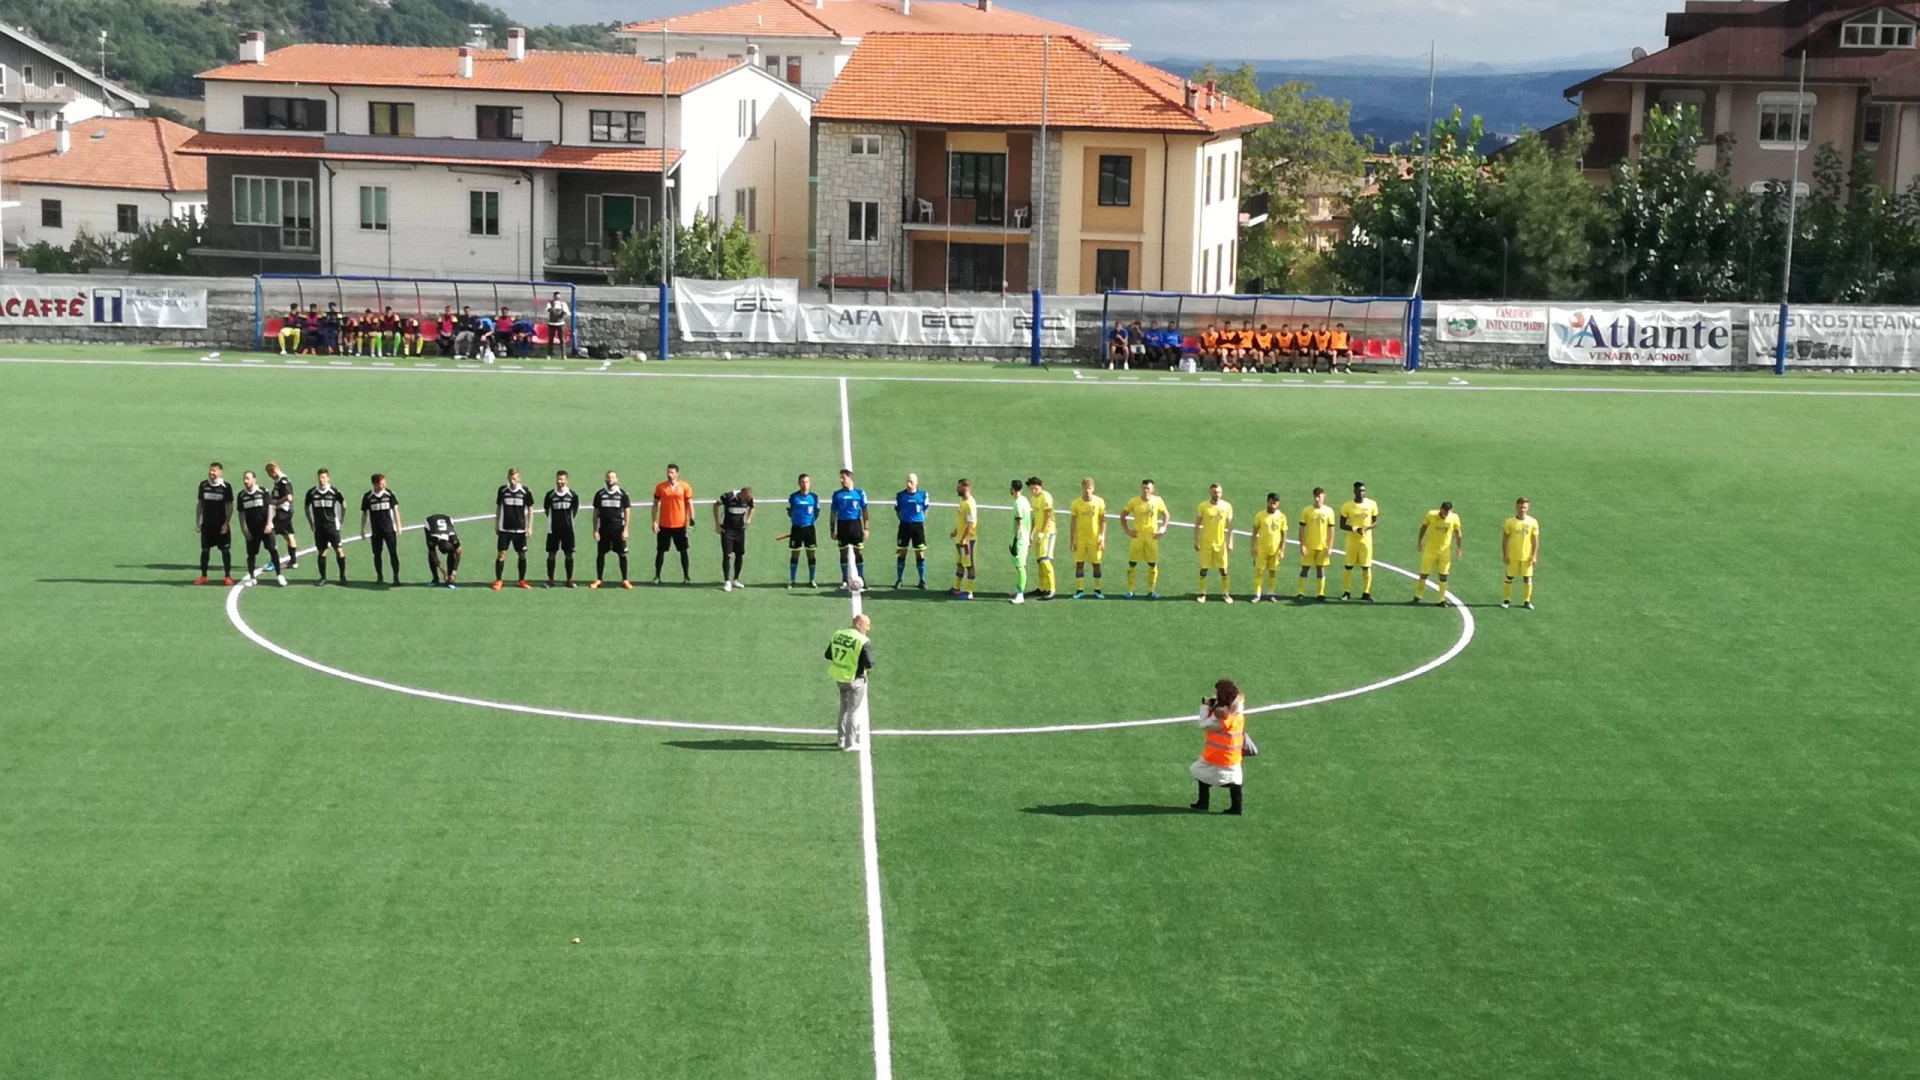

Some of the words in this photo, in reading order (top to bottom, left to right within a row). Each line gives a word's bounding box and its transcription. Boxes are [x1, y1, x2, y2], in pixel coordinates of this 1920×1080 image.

[0, 292, 87, 317] CAFFÈ
[838, 309, 883, 326] AFA
[1574, 314, 1729, 349] Atlante
[1589, 352, 1639, 361] VENAFRO
[1647, 353, 1691, 362] AGNONE
